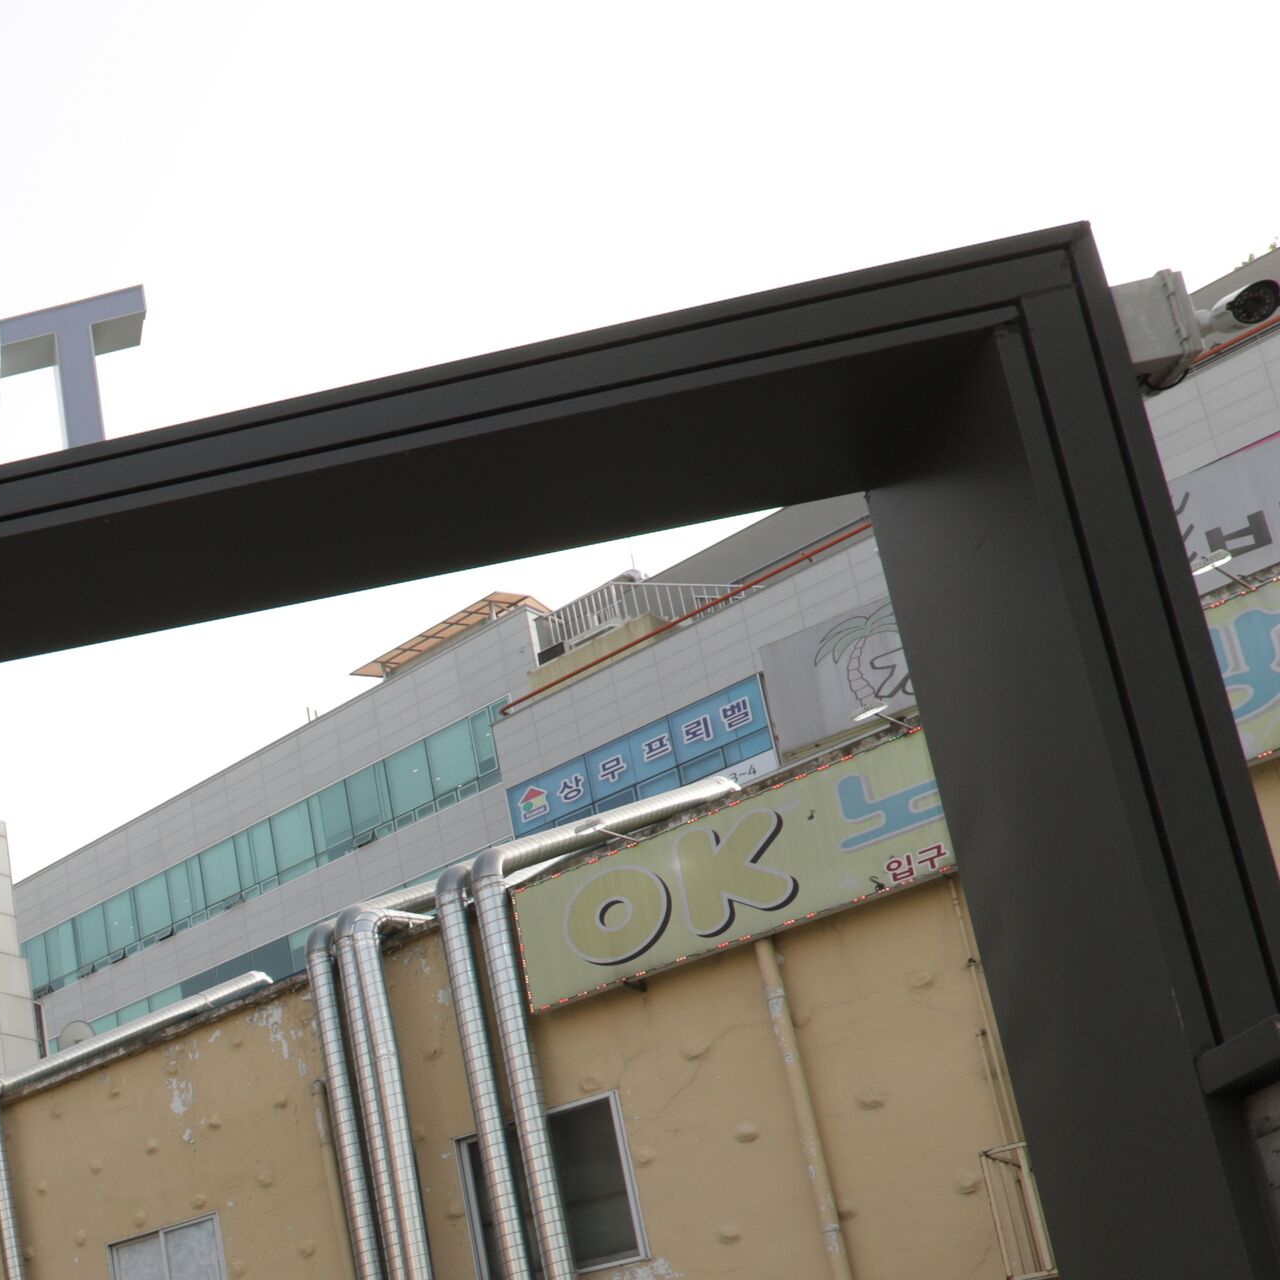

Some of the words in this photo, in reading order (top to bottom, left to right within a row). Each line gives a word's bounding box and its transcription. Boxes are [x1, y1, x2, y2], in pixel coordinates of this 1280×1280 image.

[556, 696, 753, 804] 상무프뢰벨
[563, 808, 800, 967] OK
[885, 843, 949, 884] 입구
